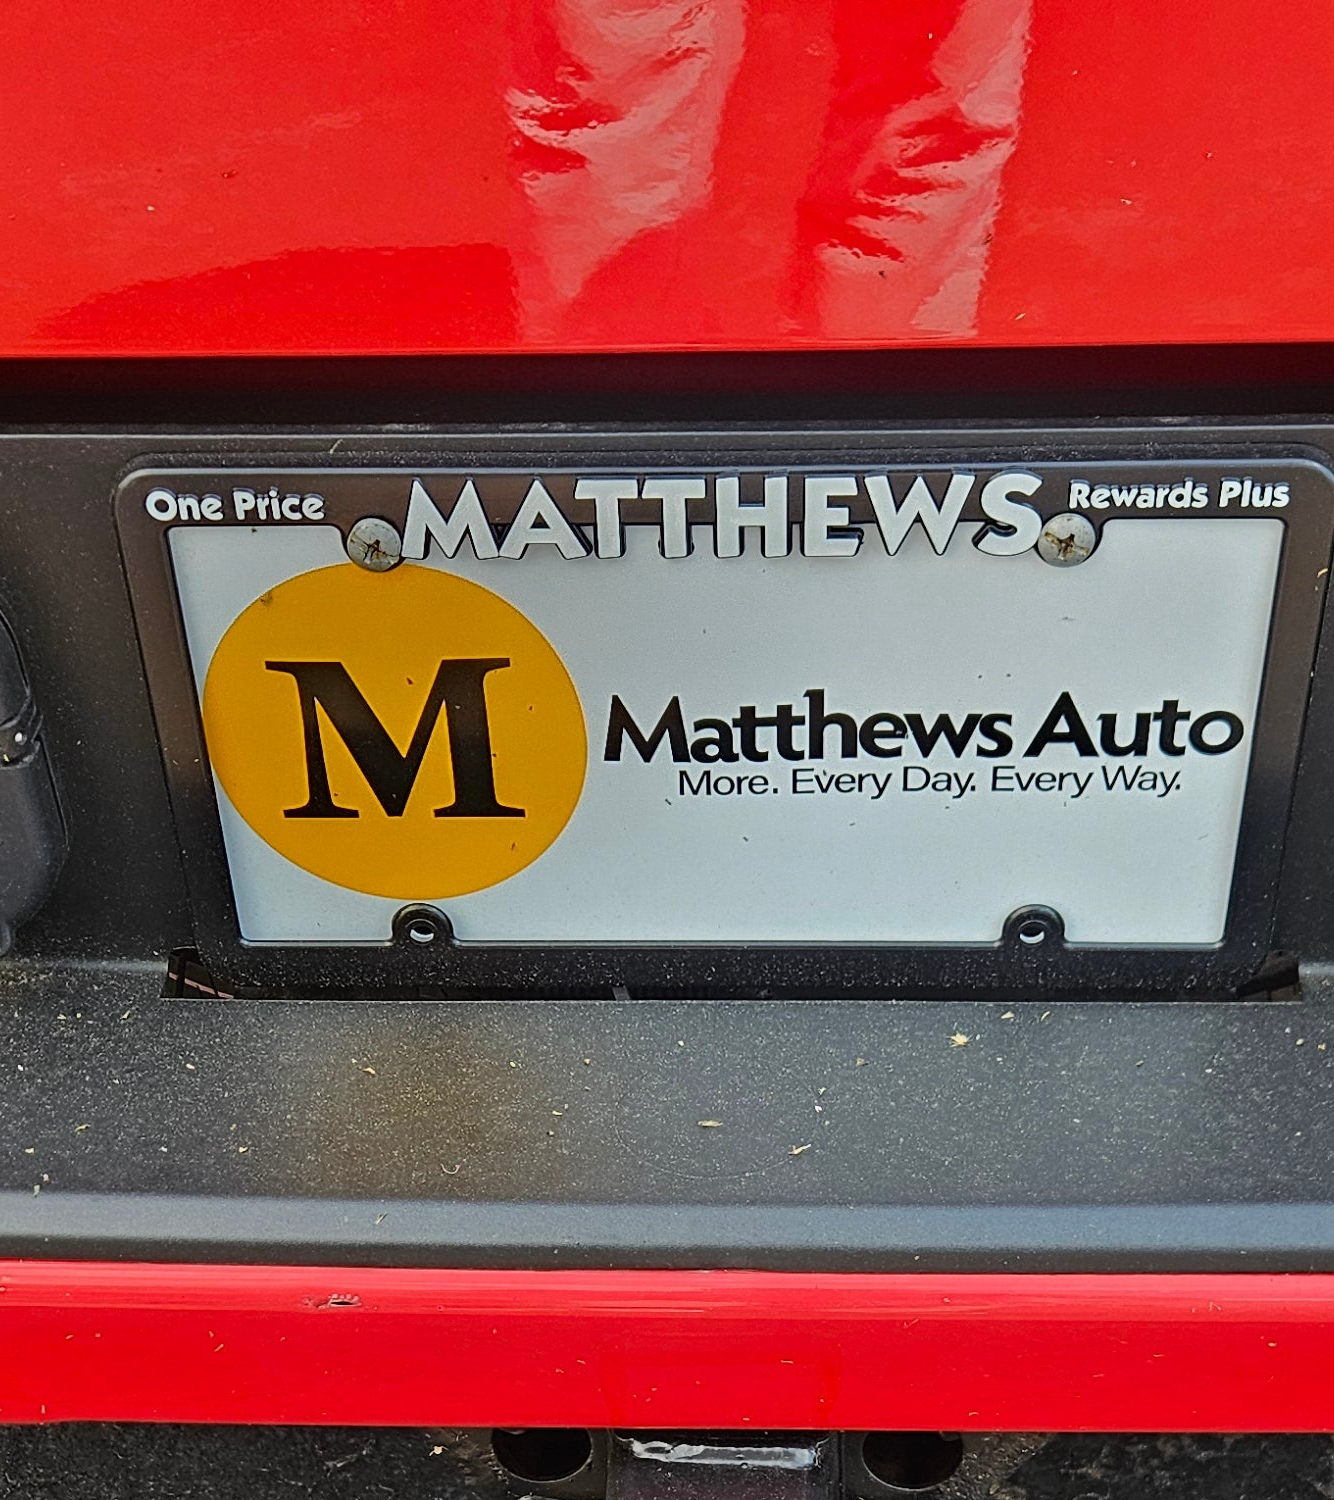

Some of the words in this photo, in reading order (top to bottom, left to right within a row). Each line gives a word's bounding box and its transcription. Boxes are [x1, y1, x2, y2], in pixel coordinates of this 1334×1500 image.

[145, 488, 223, 521] One
[233, 488, 325, 521] Price
[400, 474, 1044, 560] MATTHEWS
[1068, 478, 1209, 510] Rewards
[1218, 477, 1291, 509] Plus
[264, 657, 526, 819] M
[603, 688, 1014, 763] Matthews
[1022, 691, 1245, 758] Auto
[679, 769, 780, 796] More.
[791, 767, 891, 800] Every
[902, 766, 977, 799] Day.
[991, 766, 1094, 798] Every
[1100, 764, 1182, 796] Way.
